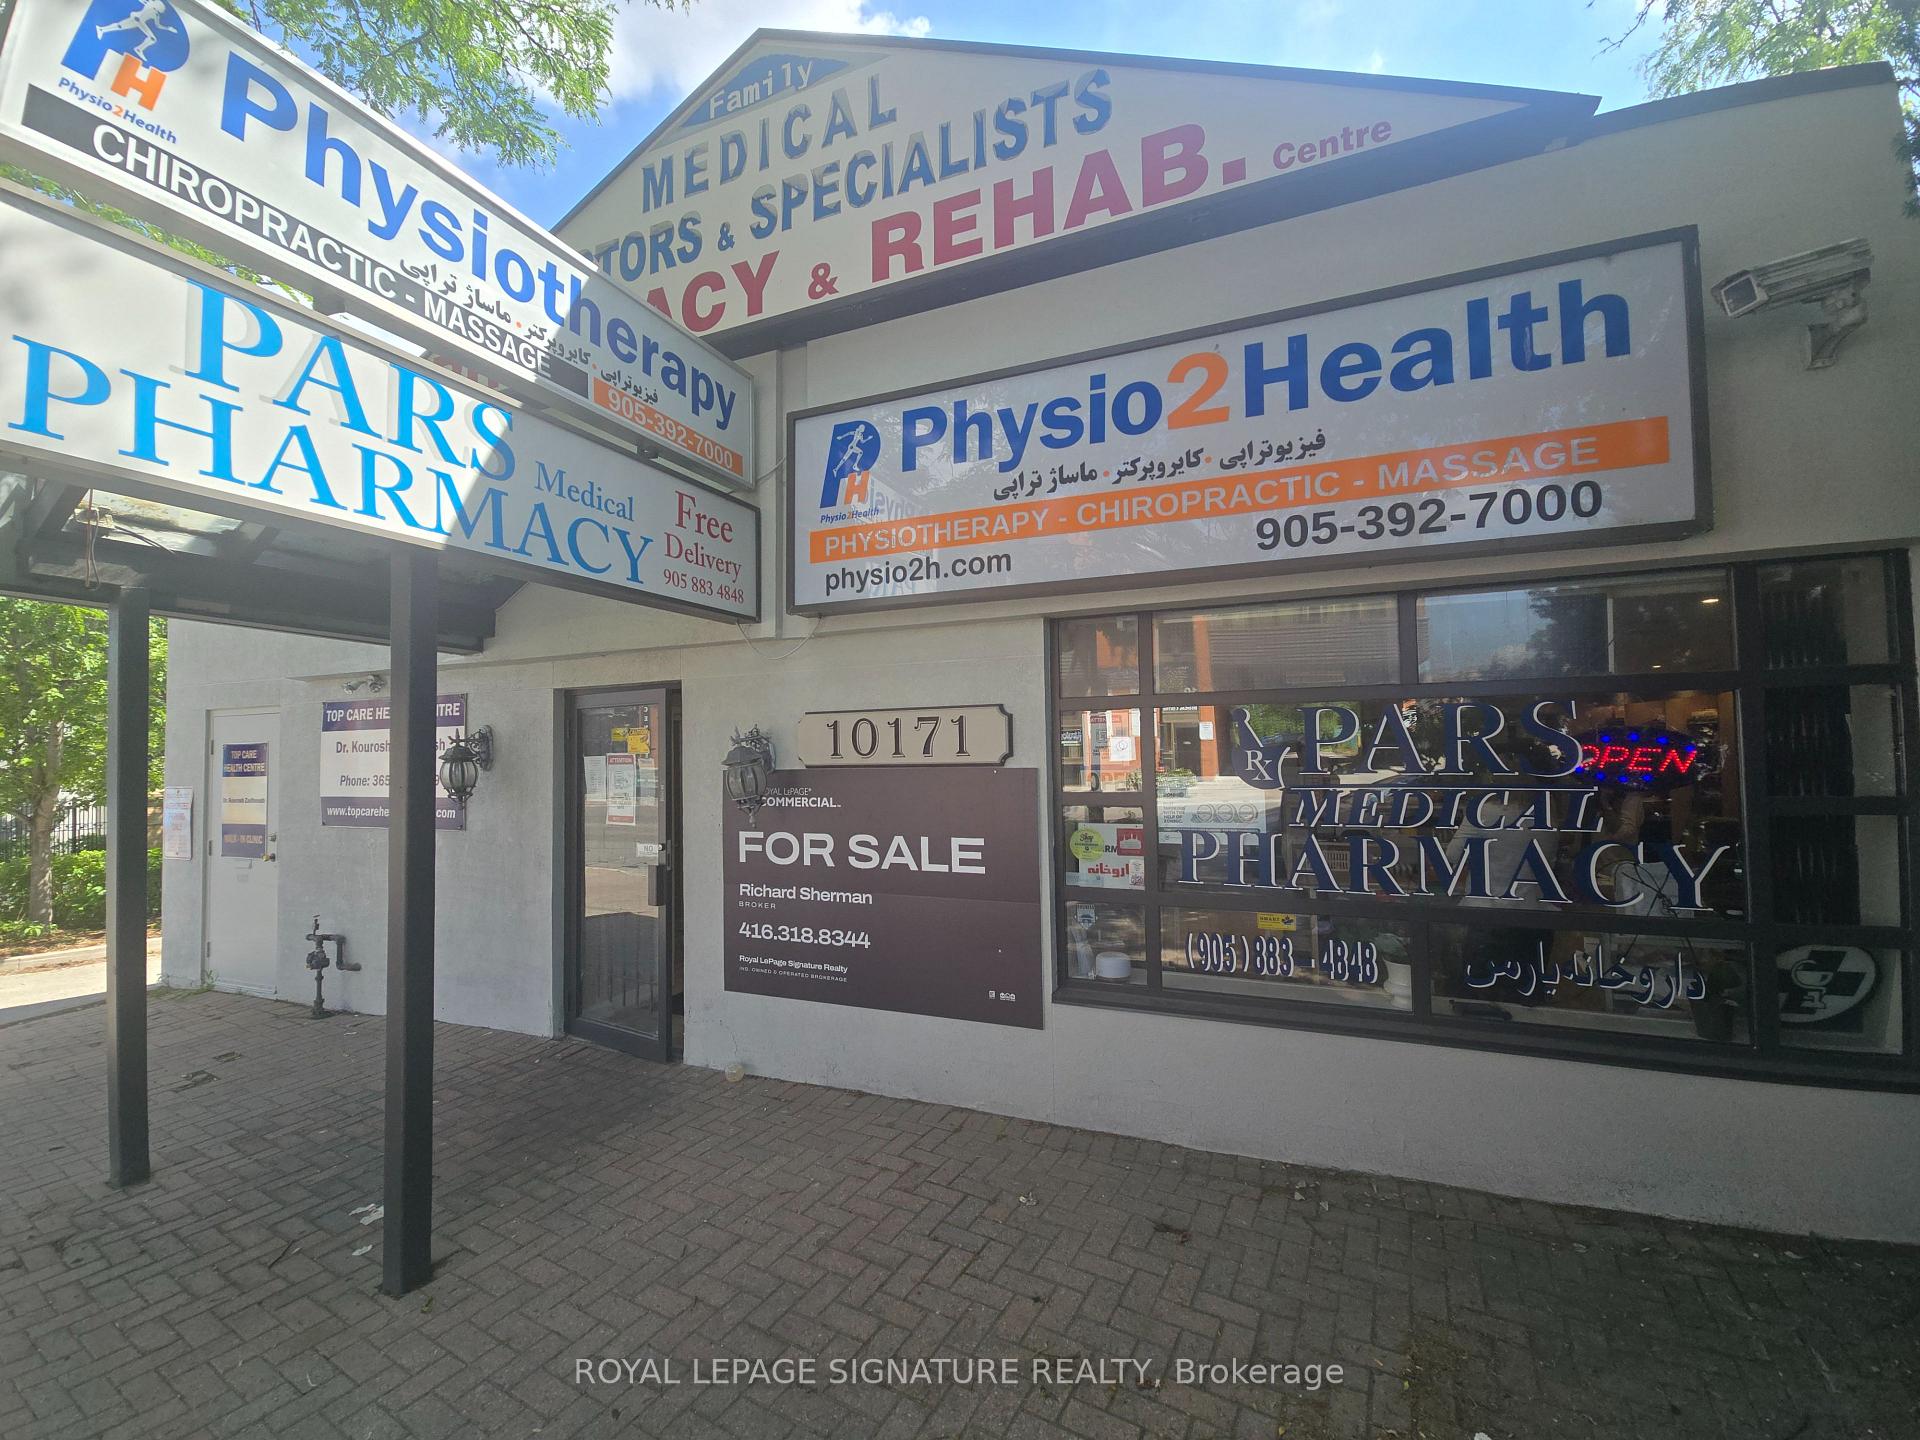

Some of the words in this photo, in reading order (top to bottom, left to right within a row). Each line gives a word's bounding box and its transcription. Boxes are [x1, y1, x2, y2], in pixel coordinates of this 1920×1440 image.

[58, 76, 178, 145] Physio2Health
[709, 56, 814, 116] Family
[642, 73, 898, 213] MEDICAL
[581, 211, 703, 282] TORS
[717, 221, 736, 251] &
[750, 67, 1112, 240] SPECIALISTS
[93, 123, 397, 301] CHIROPRACTIC
[423, 290, 551, 378] MASSAGE
[221, 50, 737, 431] Physiotherapy
[646, 250, 780, 333] CY
[807, 262, 840, 300] &
[870, 123, 1246, 281] REHAB.
[1272, 119, 1392, 170] Centre
[184, 277, 516, 482] PARS
[901, 278, 1632, 473] Physio2Health
[607, 387, 734, 470] 905-392-7000
[6, 334, 655, 586] PHARMACY
[534, 460, 635, 523] Medical
[674, 490, 734, 543] Free
[820, 505, 880, 524] Physio2Health
[824, 507, 1050, 557] PHYSIOTHERAPY
[1077, 470, 1340, 527] CHIROPRACTIC
[1378, 435, 1600, 491] MASSAGE
[1256, 480, 1603, 550] 905-392-7000
[663, 532, 742, 584] Delivery
[825, 550, 1012, 596] physio2h.com
[662, 568, 688, 590] 905
[690, 574, 715, 597] 883
[716, 581, 745, 604] 4848
[326, 710, 344, 722] TOP
[346, 707, 374, 721] CARE
[826, 714, 971, 759] 10171
[1296, 700, 1586, 779] PARS
[336, 741, 349, 754] Dr.
[351, 739, 391, 753] Kourosh
[1581, 743, 1698, 775] OPEN
[340, 774, 370, 787] Phone:
[1288, 787, 1603, 833] MEDICAL
[738, 831, 836, 867] FOR
[847, 833, 986, 875] SALE
[1087, 862, 1130, 878] اروخانه
[1176, 827, 1731, 912] PHARMACY
[738, 900, 777, 909] BROKER
[739, 883, 797, 900] Richard
[799, 886, 873, 905] Sherman
[738, 921, 872, 950] 416.318.8344
[1252, 935, 1294, 977] 883
[1321, 939, 1379, 984] 4848
[739, 954, 759, 965] Royal
[760, 957, 788, 968] LePage
[788, 959, 823, 970] Signature
[823, 963, 849, 974] Realty
